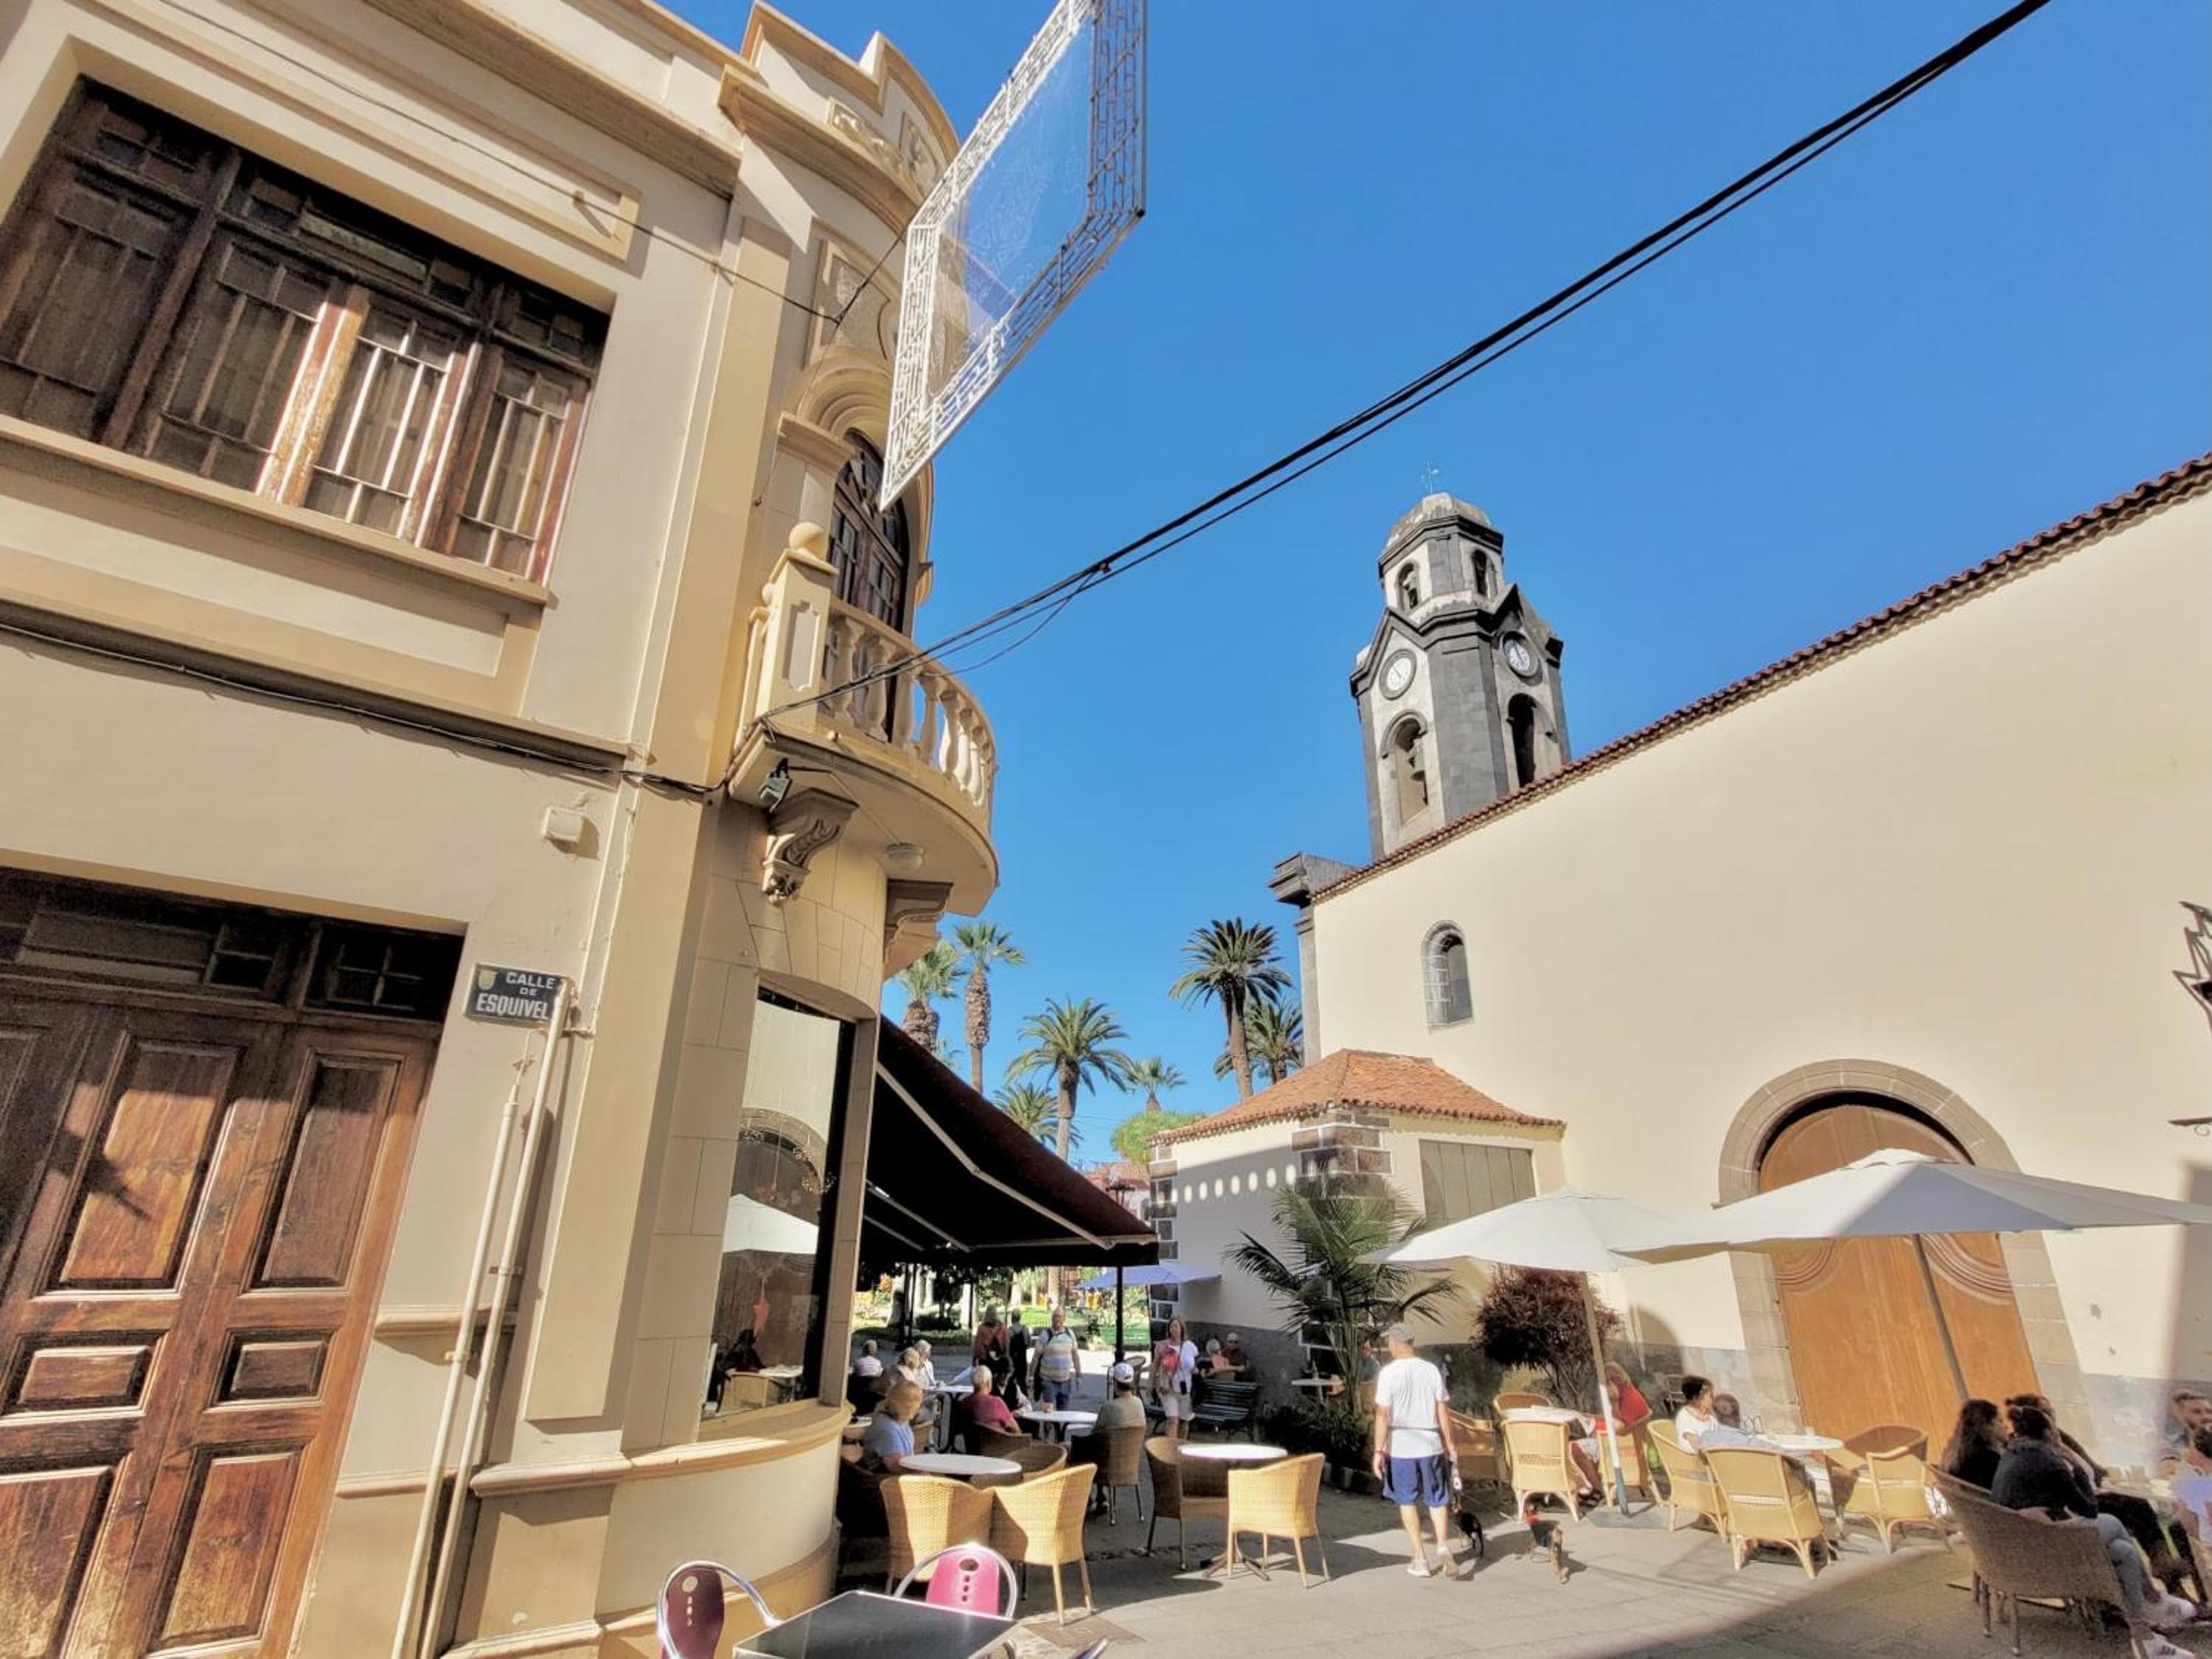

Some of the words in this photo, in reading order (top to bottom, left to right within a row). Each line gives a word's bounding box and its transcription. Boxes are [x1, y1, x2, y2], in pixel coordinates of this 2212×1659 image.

[506, 972, 555, 990] CALLE
[519, 987, 538, 996] DE
[476, 993, 549, 1020] ESQUIVEL
